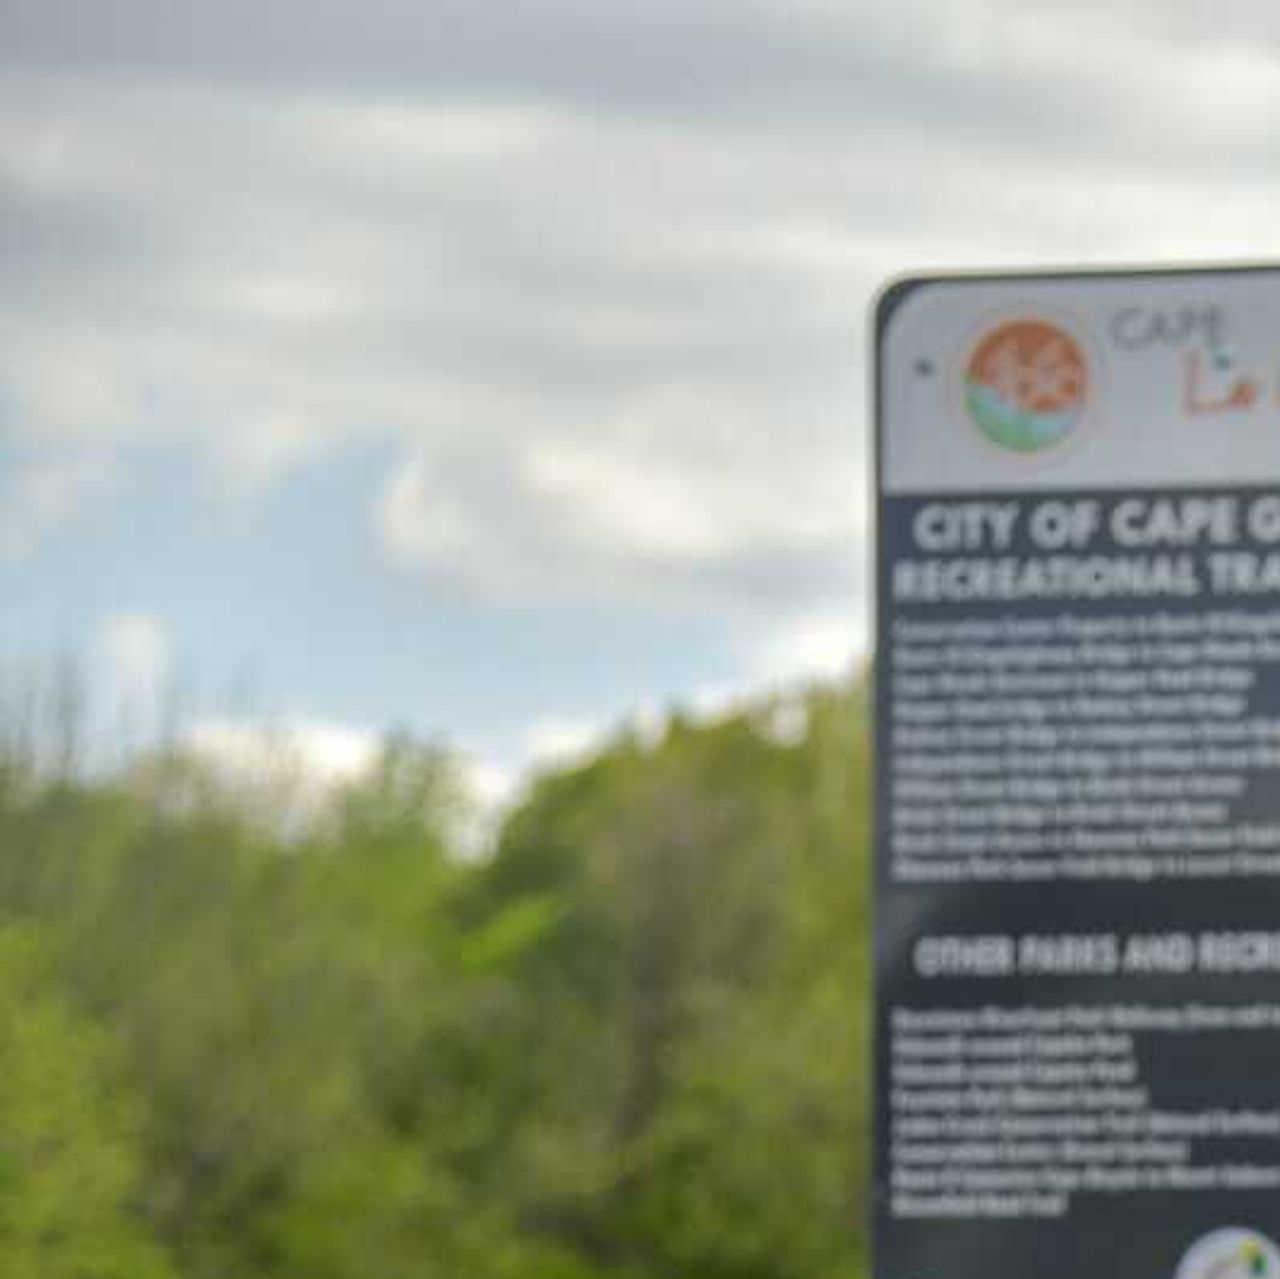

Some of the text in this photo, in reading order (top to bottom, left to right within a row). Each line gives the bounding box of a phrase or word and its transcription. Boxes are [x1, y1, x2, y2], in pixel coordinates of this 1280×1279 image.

[1108, 304, 1224, 351] CAPE
[912, 502, 1019, 550] CITY
[1029, 500, 1100, 549] OF
[1110, 496, 1237, 547] CAPE
[892, 555, 1202, 600] RECREATIONAL
[913, 933, 1014, 977] OTHER
[1016, 931, 1117, 975] PARKS
[1121, 929, 1193, 973] AND
